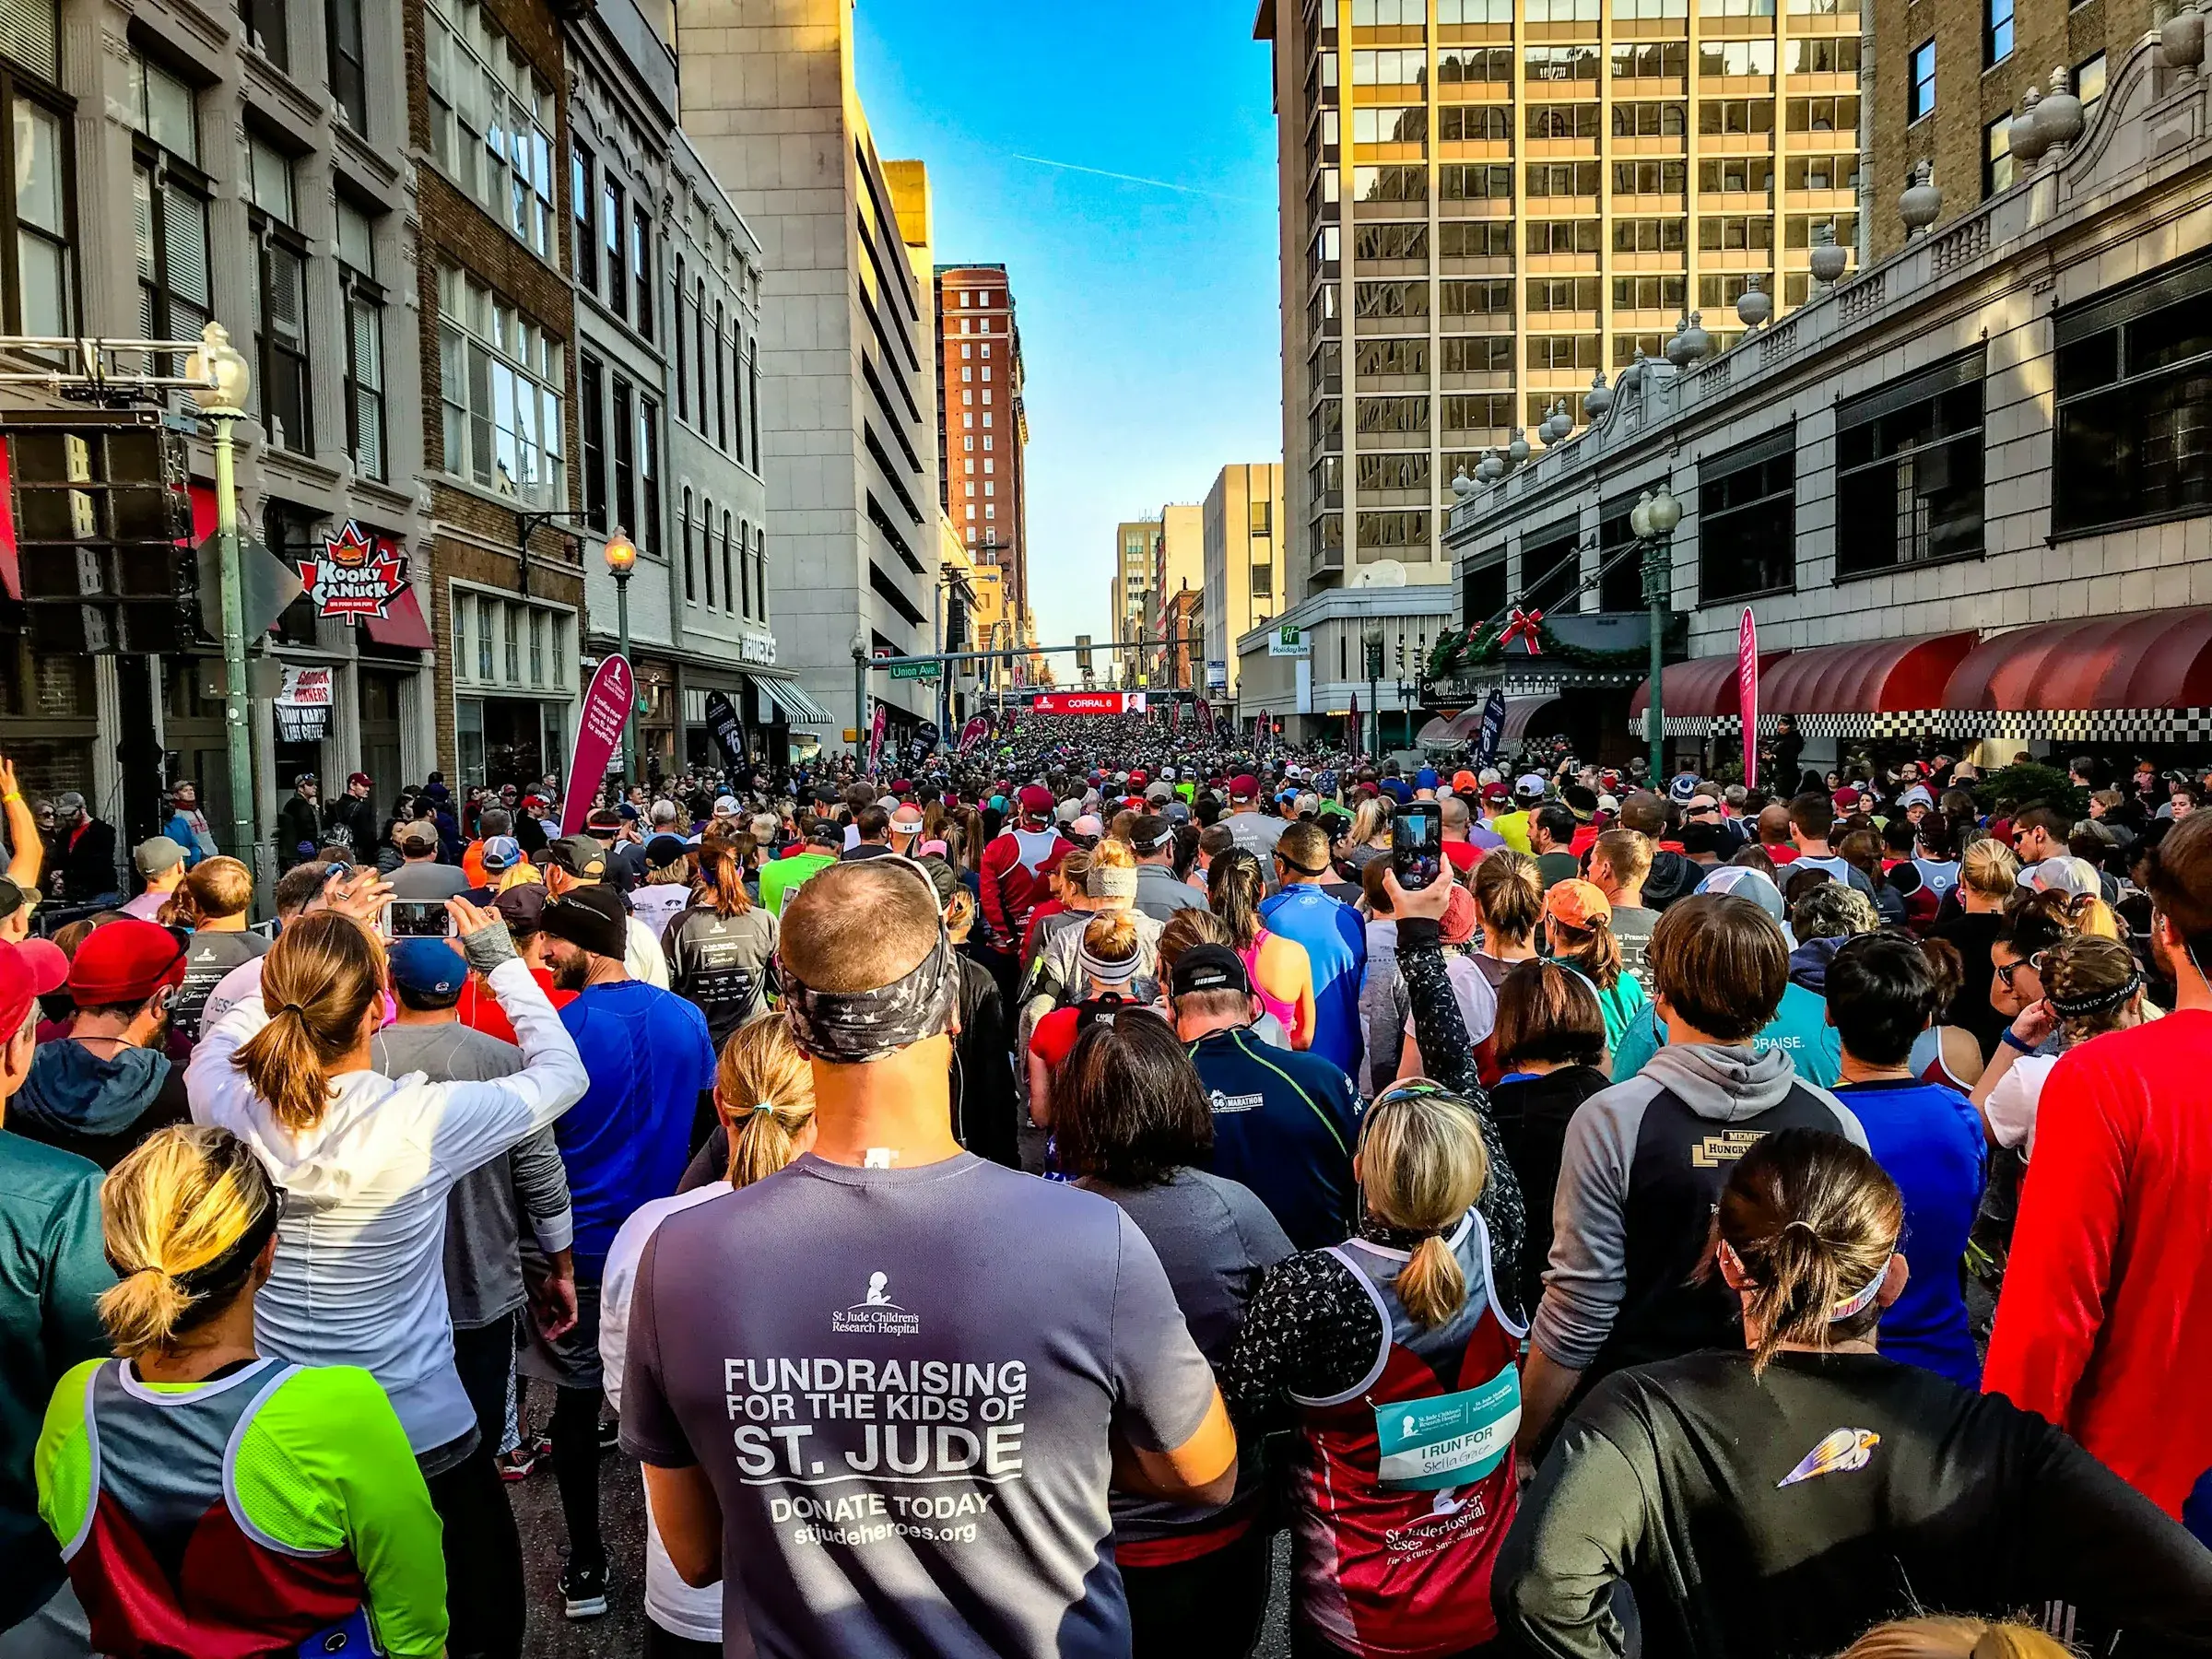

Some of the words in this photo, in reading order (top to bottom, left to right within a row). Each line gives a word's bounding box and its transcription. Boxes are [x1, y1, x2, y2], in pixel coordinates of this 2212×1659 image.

[317, 559, 382, 582] KOOKY
[742, 631, 776, 664] HUEY'S
[1273, 645, 1298, 653] Holiday
[892, 666, 917, 677] Union
[1068, 700, 1104, 708] CORRAL
[1752, 1037, 1806, 1050] DRAISE.
[1213, 1099, 1225, 1107] 66
[1228, 1096, 1263, 1107] MARATHON
[1729, 1132, 1766, 1142] MEMP
[832, 1311, 845, 1322] St.
[846, 1312, 869, 1324] Jude
[871, 1312, 919, 1324] Children's
[832, 1322, 876, 1333] Research
[878, 1323, 919, 1336] Hospital
[724, 1358, 1027, 1397] FUNDRAISING
[726, 1394, 795, 1421] FOR
[805, 1394, 876, 1420] THE
[887, 1394, 970, 1422] KIDS
[980, 1394, 1027, 1422] OF
[734, 1425, 825, 1477] ST.
[844, 1423, 1025, 1475] JUDE
[1421, 1448, 1426, 1459] I
[1430, 1439, 1461, 1457] RUN
[1465, 1427, 1493, 1447] FOR
[770, 1493, 888, 1524] DONATE
[893, 1492, 994, 1520] TODAY
[794, 1522, 977, 1547] stjudeheroes.org
[1412, 1547, 1434, 1559] cures.
